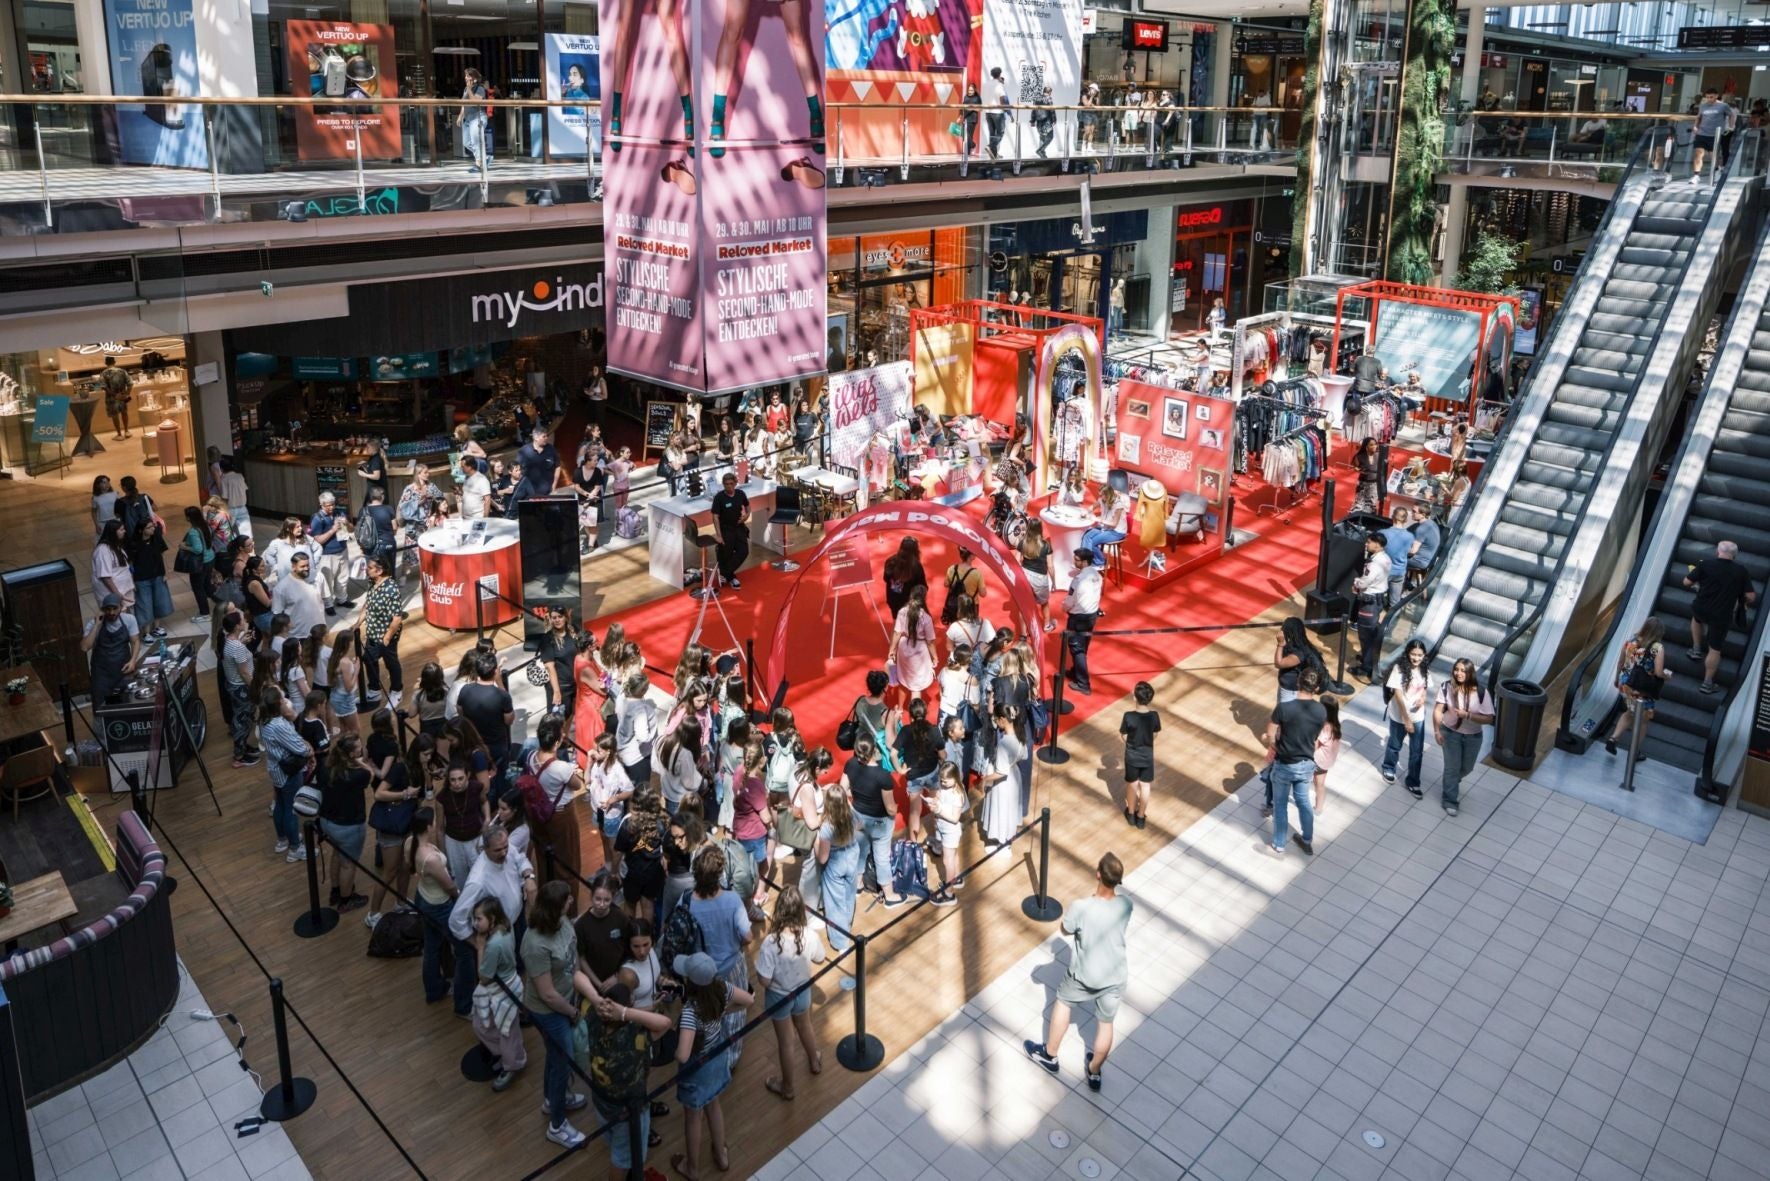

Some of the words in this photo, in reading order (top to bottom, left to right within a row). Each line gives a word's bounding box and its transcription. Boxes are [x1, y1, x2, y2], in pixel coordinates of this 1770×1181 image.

[116, 11, 171, 29] VERTUO
[173, 10, 193, 28] UP
[316, 31, 355, 40] VERTUO
[566, 42, 594, 51] VERTUO
[676, 222, 688, 237] UHR
[716, 222, 728, 238] 29.
[731, 222, 737, 237] &
[738, 221, 752, 236] 30.
[754, 220, 769, 235] MAI
[776, 218, 787, 233] AB
[788, 217, 796, 232] 10
[798, 216, 813, 231] UHR
[617, 235, 654, 253] Reloved
[655, 242, 688, 258] Market
[718, 242, 770, 259] Reloved
[772, 238, 812, 254] Market
[866, 252, 889, 264] eyes
[905, 247, 930, 257] more
[616, 257, 670, 292] STYLISCHE
[717, 262, 788, 297] STYLISCHE
[616, 286, 692, 320] SECOND-HAND-MODE
[718, 288, 814, 320] SECOND-HAND-MODE
[616, 307, 662, 335] ENTDECKEN!
[719, 316, 778, 343] ENTDECKEN!
[834, 374, 876, 410] ilias
[36, 426, 63, 436] -50%
[1147, 440, 1193, 460] Reloved
[1152, 453, 1192, 472] Market
[907, 511, 1016, 586] Reloved
[423, 571, 465, 597] Westfield
[430, 593, 452, 606] Club
[131, 721, 154, 731] GELA
